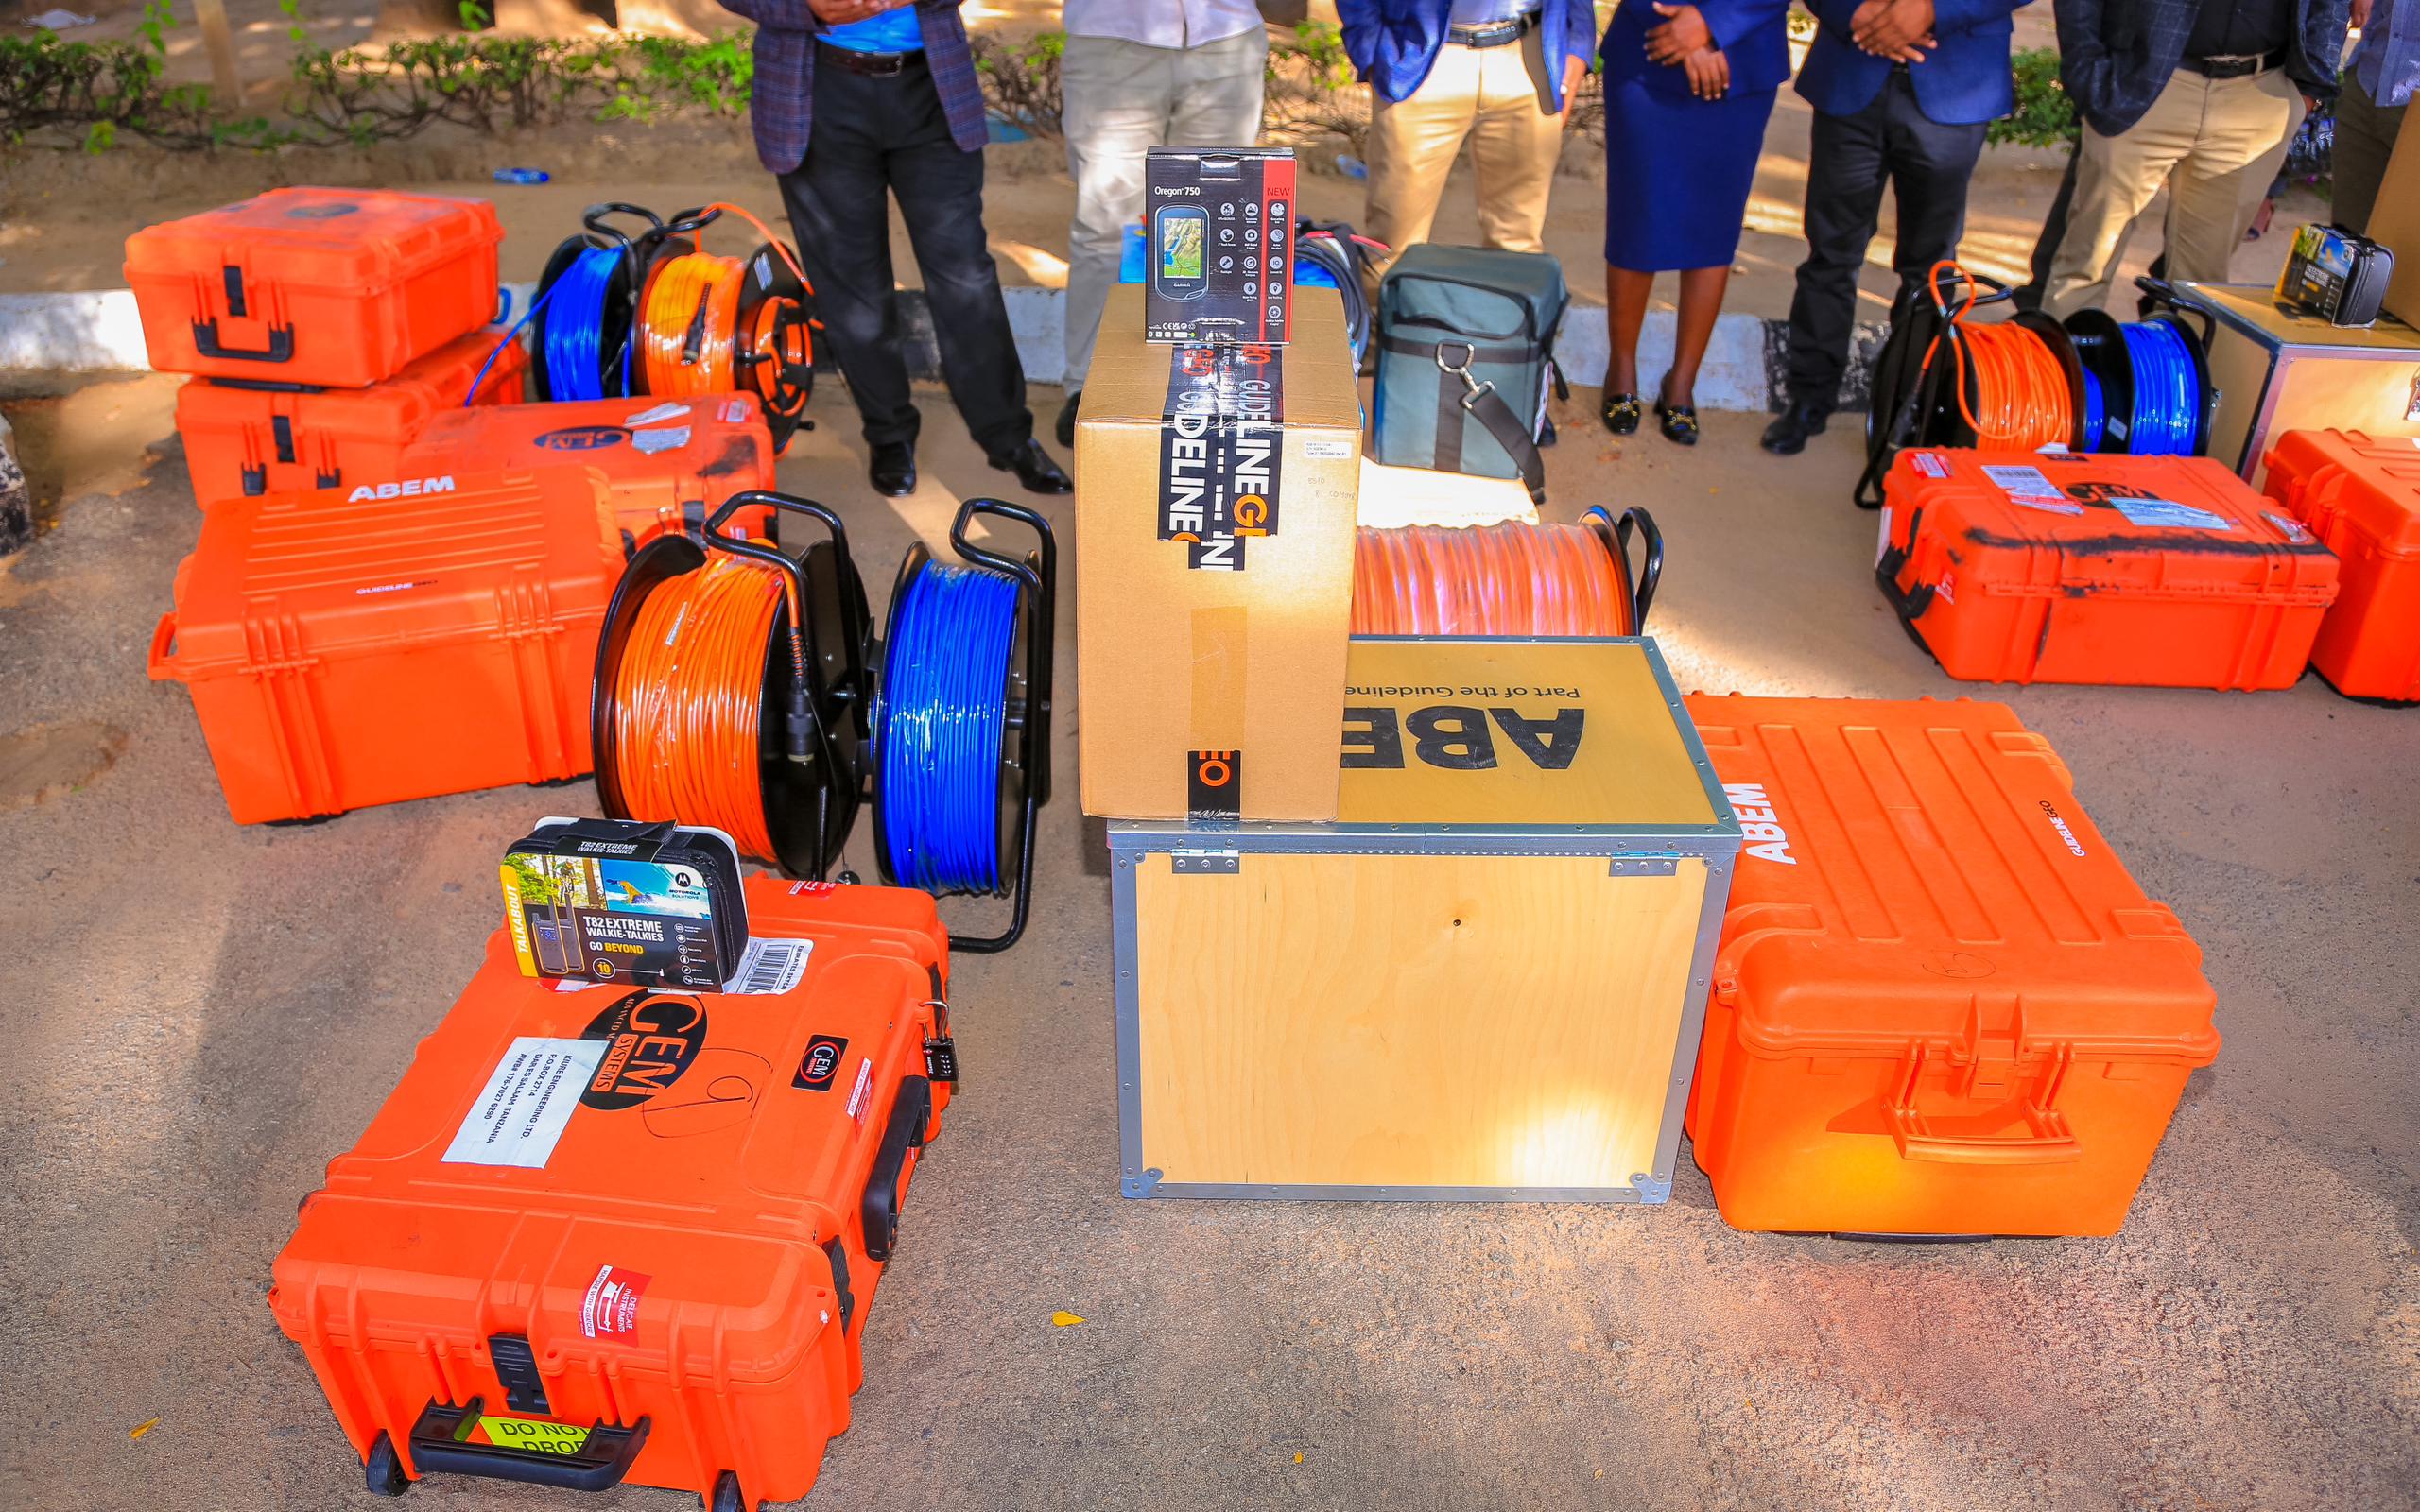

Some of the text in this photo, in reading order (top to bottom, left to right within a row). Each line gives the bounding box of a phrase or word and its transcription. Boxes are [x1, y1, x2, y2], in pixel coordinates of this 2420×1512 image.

[1154, 186, 1201, 197] Oregon 750
[348, 475, 455, 503] ABEM
[1345, 686, 1581, 699] Part of the Guideline
[1722, 782, 1797, 865] ABEM
[577, 846, 634, 855] WALKIE-TALKIES
[596, 842, 639, 850] EXTREME
[506, 884, 528, 953] TALKABOUT
[583, 916, 663, 933] T82 EXTREME
[586, 927, 664, 942] WALKIE-TALKIES
[589, 941, 644, 954] GO BEYOND
[597, 963, 611, 973] 10
[615, 994, 703, 1096] CEM
[596, 1038, 633, 1088] SYSTEMS
[812, 1046, 835, 1075] CEM
[484, 1053, 527, 1120] AWB# 176-7027 6290
[520, 1055, 573, 1139] KIURE ENGINEERING LTD.
[528, 1080, 542, 1096] 2714
[486, 1054, 542, 1143] DAR ES SALAAM TANZANIA
[592, 1269, 608, 1290] HANDLE
[586, 1291, 596, 1306] WITH
[617, 1288, 633, 1332] INSTRUMENTS
[625, 1297, 637, 1330] DELICATE
[499, 1422, 536, 1435] DO
